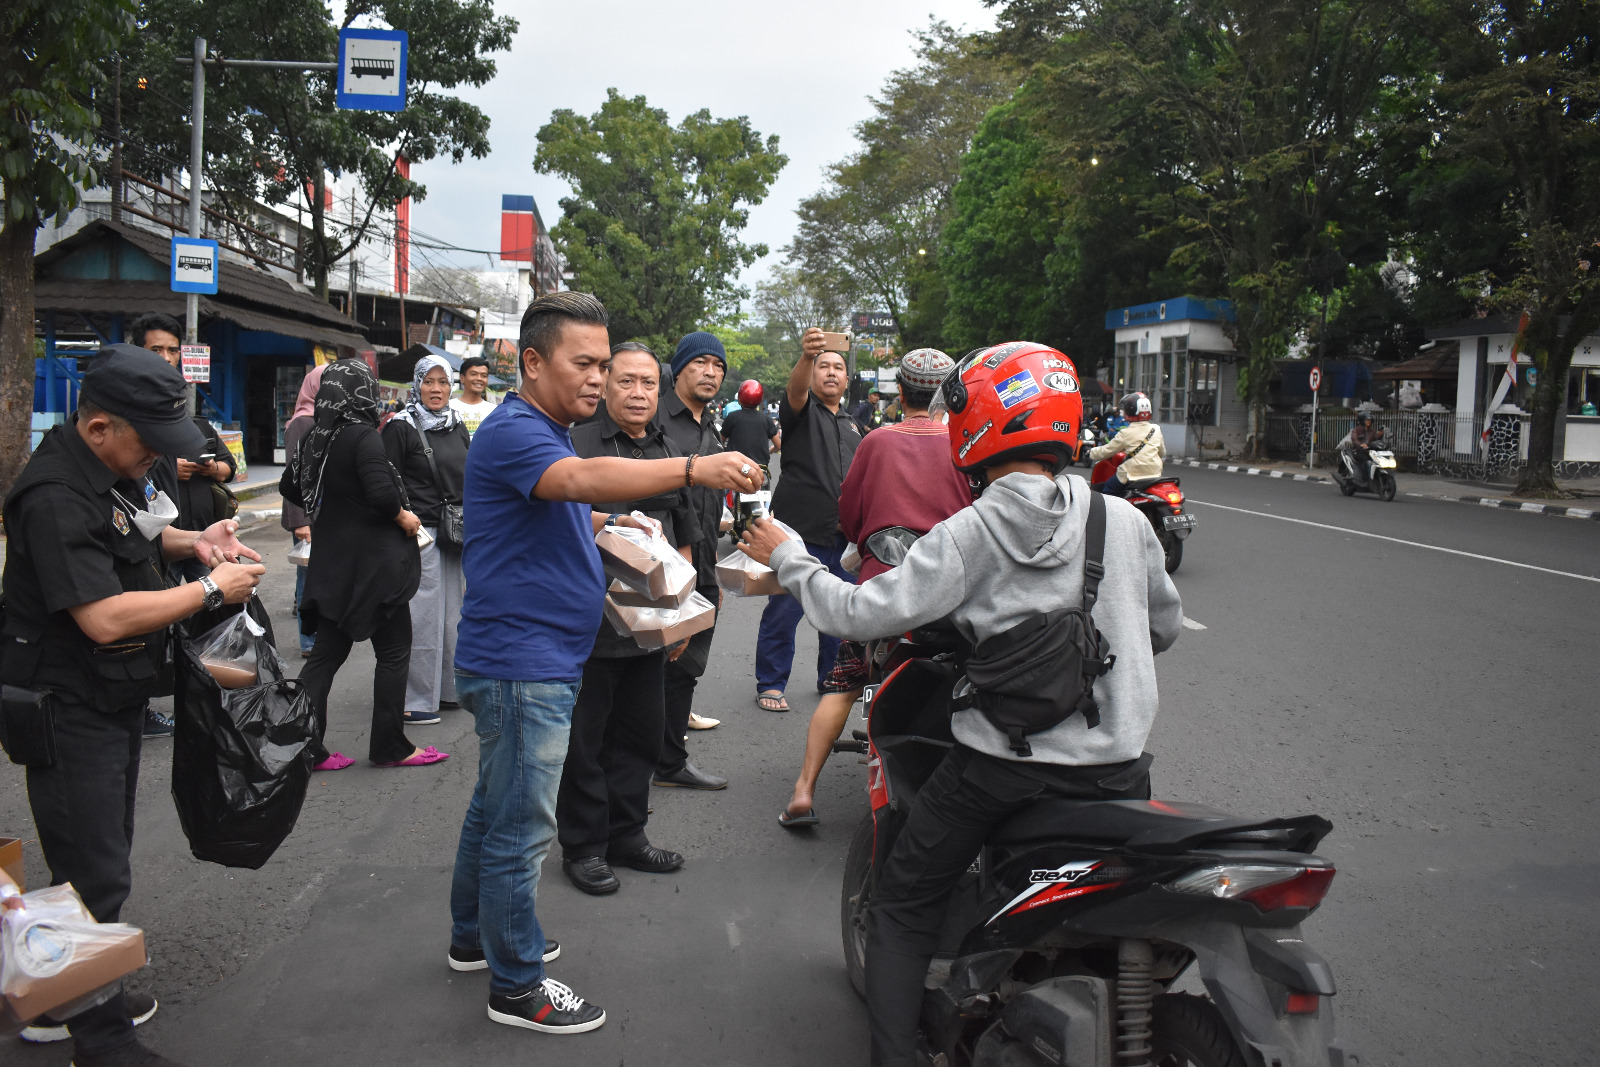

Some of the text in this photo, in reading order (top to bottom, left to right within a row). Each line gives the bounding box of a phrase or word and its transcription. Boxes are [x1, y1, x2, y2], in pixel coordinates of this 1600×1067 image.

[871, 317, 893, 326] UOB
[1053, 422, 1070, 432] DOT
[865, 688, 873, 703] D
